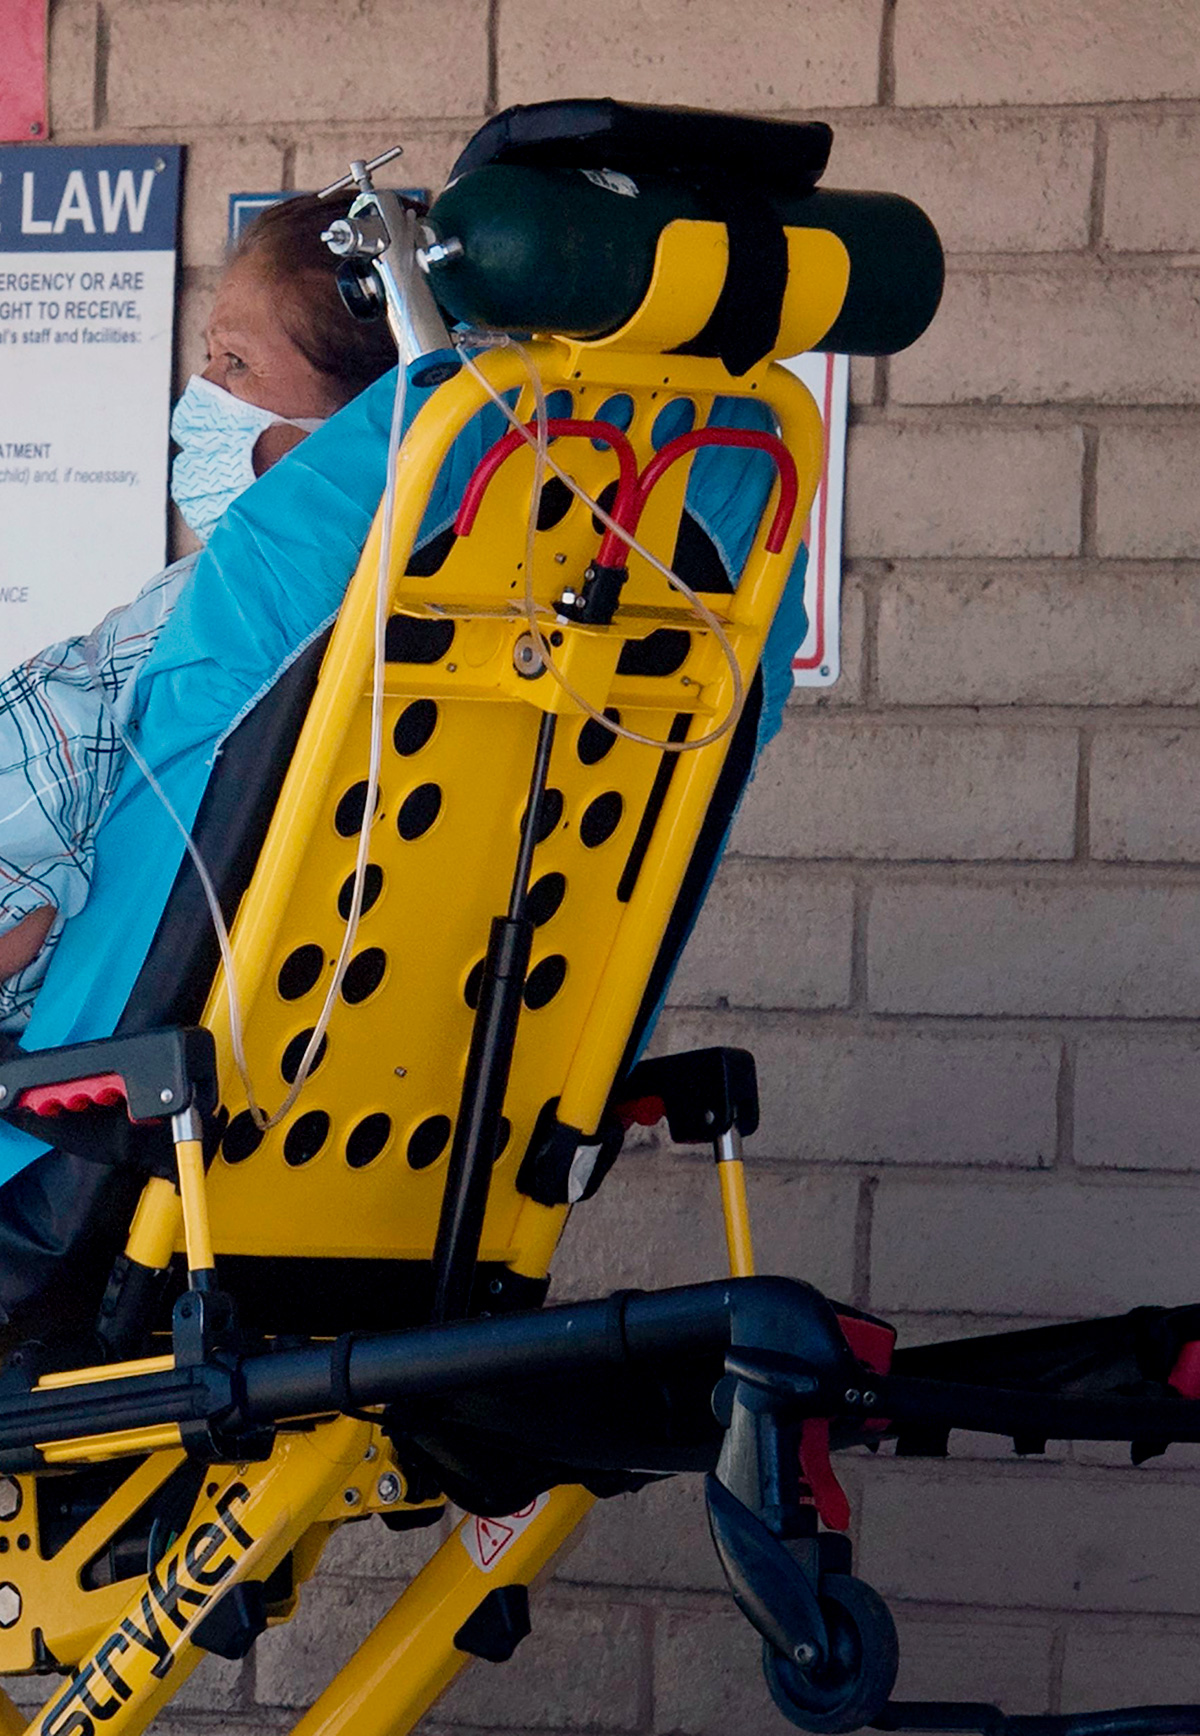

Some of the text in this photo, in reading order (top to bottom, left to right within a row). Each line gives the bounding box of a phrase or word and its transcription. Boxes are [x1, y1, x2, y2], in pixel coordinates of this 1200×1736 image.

[21, 169, 154, 234] LAW
[80, 273, 104, 290] OR
[109, 273, 144, 290] ARE
[38, 302, 59, 319] TO
[64, 301, 141, 322] RECEIVE,
[22, 329, 51, 344] staff
[55, 329, 78, 344] and
[82, 328, 141, 343] facilities:
[33, 468, 59, 486] and,
[64, 468, 72, 482] if
[75, 468, 139, 485] necessary,
[40, 1481, 256, 1736] stryker
